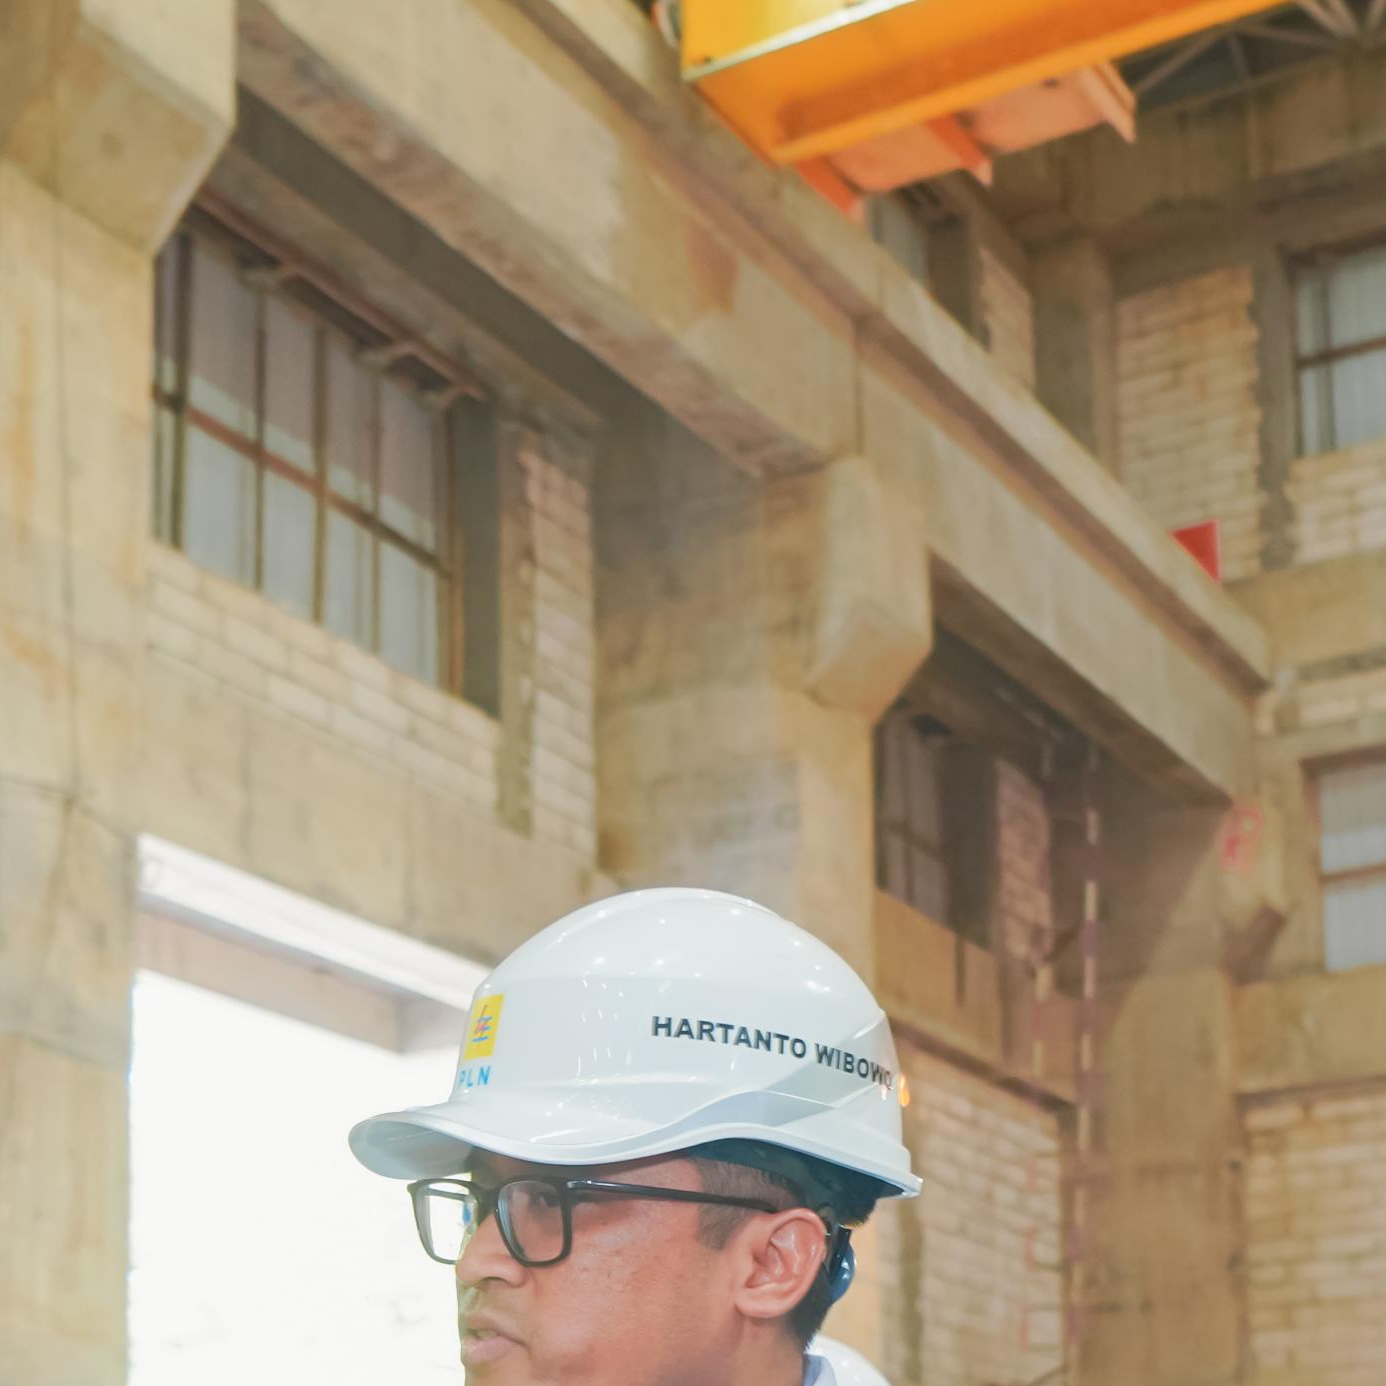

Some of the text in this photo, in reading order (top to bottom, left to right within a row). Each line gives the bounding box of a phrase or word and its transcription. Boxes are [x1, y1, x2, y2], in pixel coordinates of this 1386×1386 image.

[457, 1065, 491, 1089] PLN
[652, 1016, 894, 1091] HARTANTO WIBOWO
